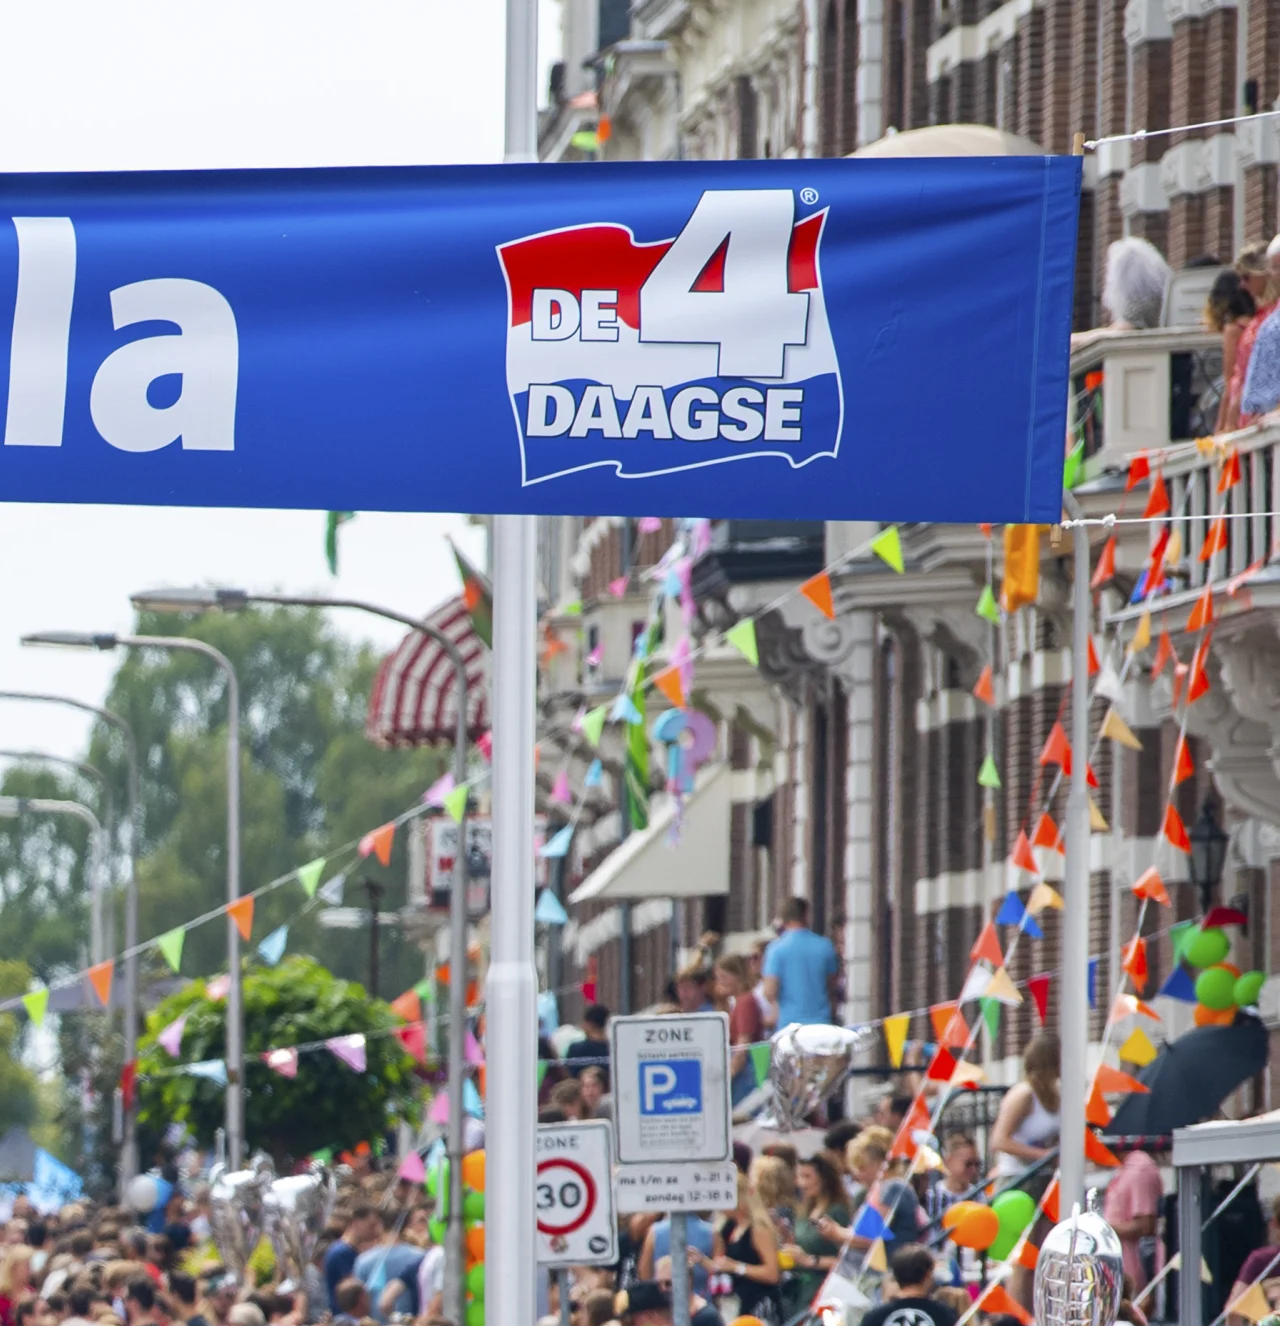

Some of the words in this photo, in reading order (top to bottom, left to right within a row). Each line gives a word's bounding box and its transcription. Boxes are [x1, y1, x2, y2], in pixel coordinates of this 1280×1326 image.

[530, 287, 620, 343] DE
[638, 188, 811, 379] 4
[525, 383, 805, 443] DAAGSE
[644, 1027, 695, 1043] ZONE
[643, 1064, 677, 1113] P
[536, 1183, 582, 1209] 30
